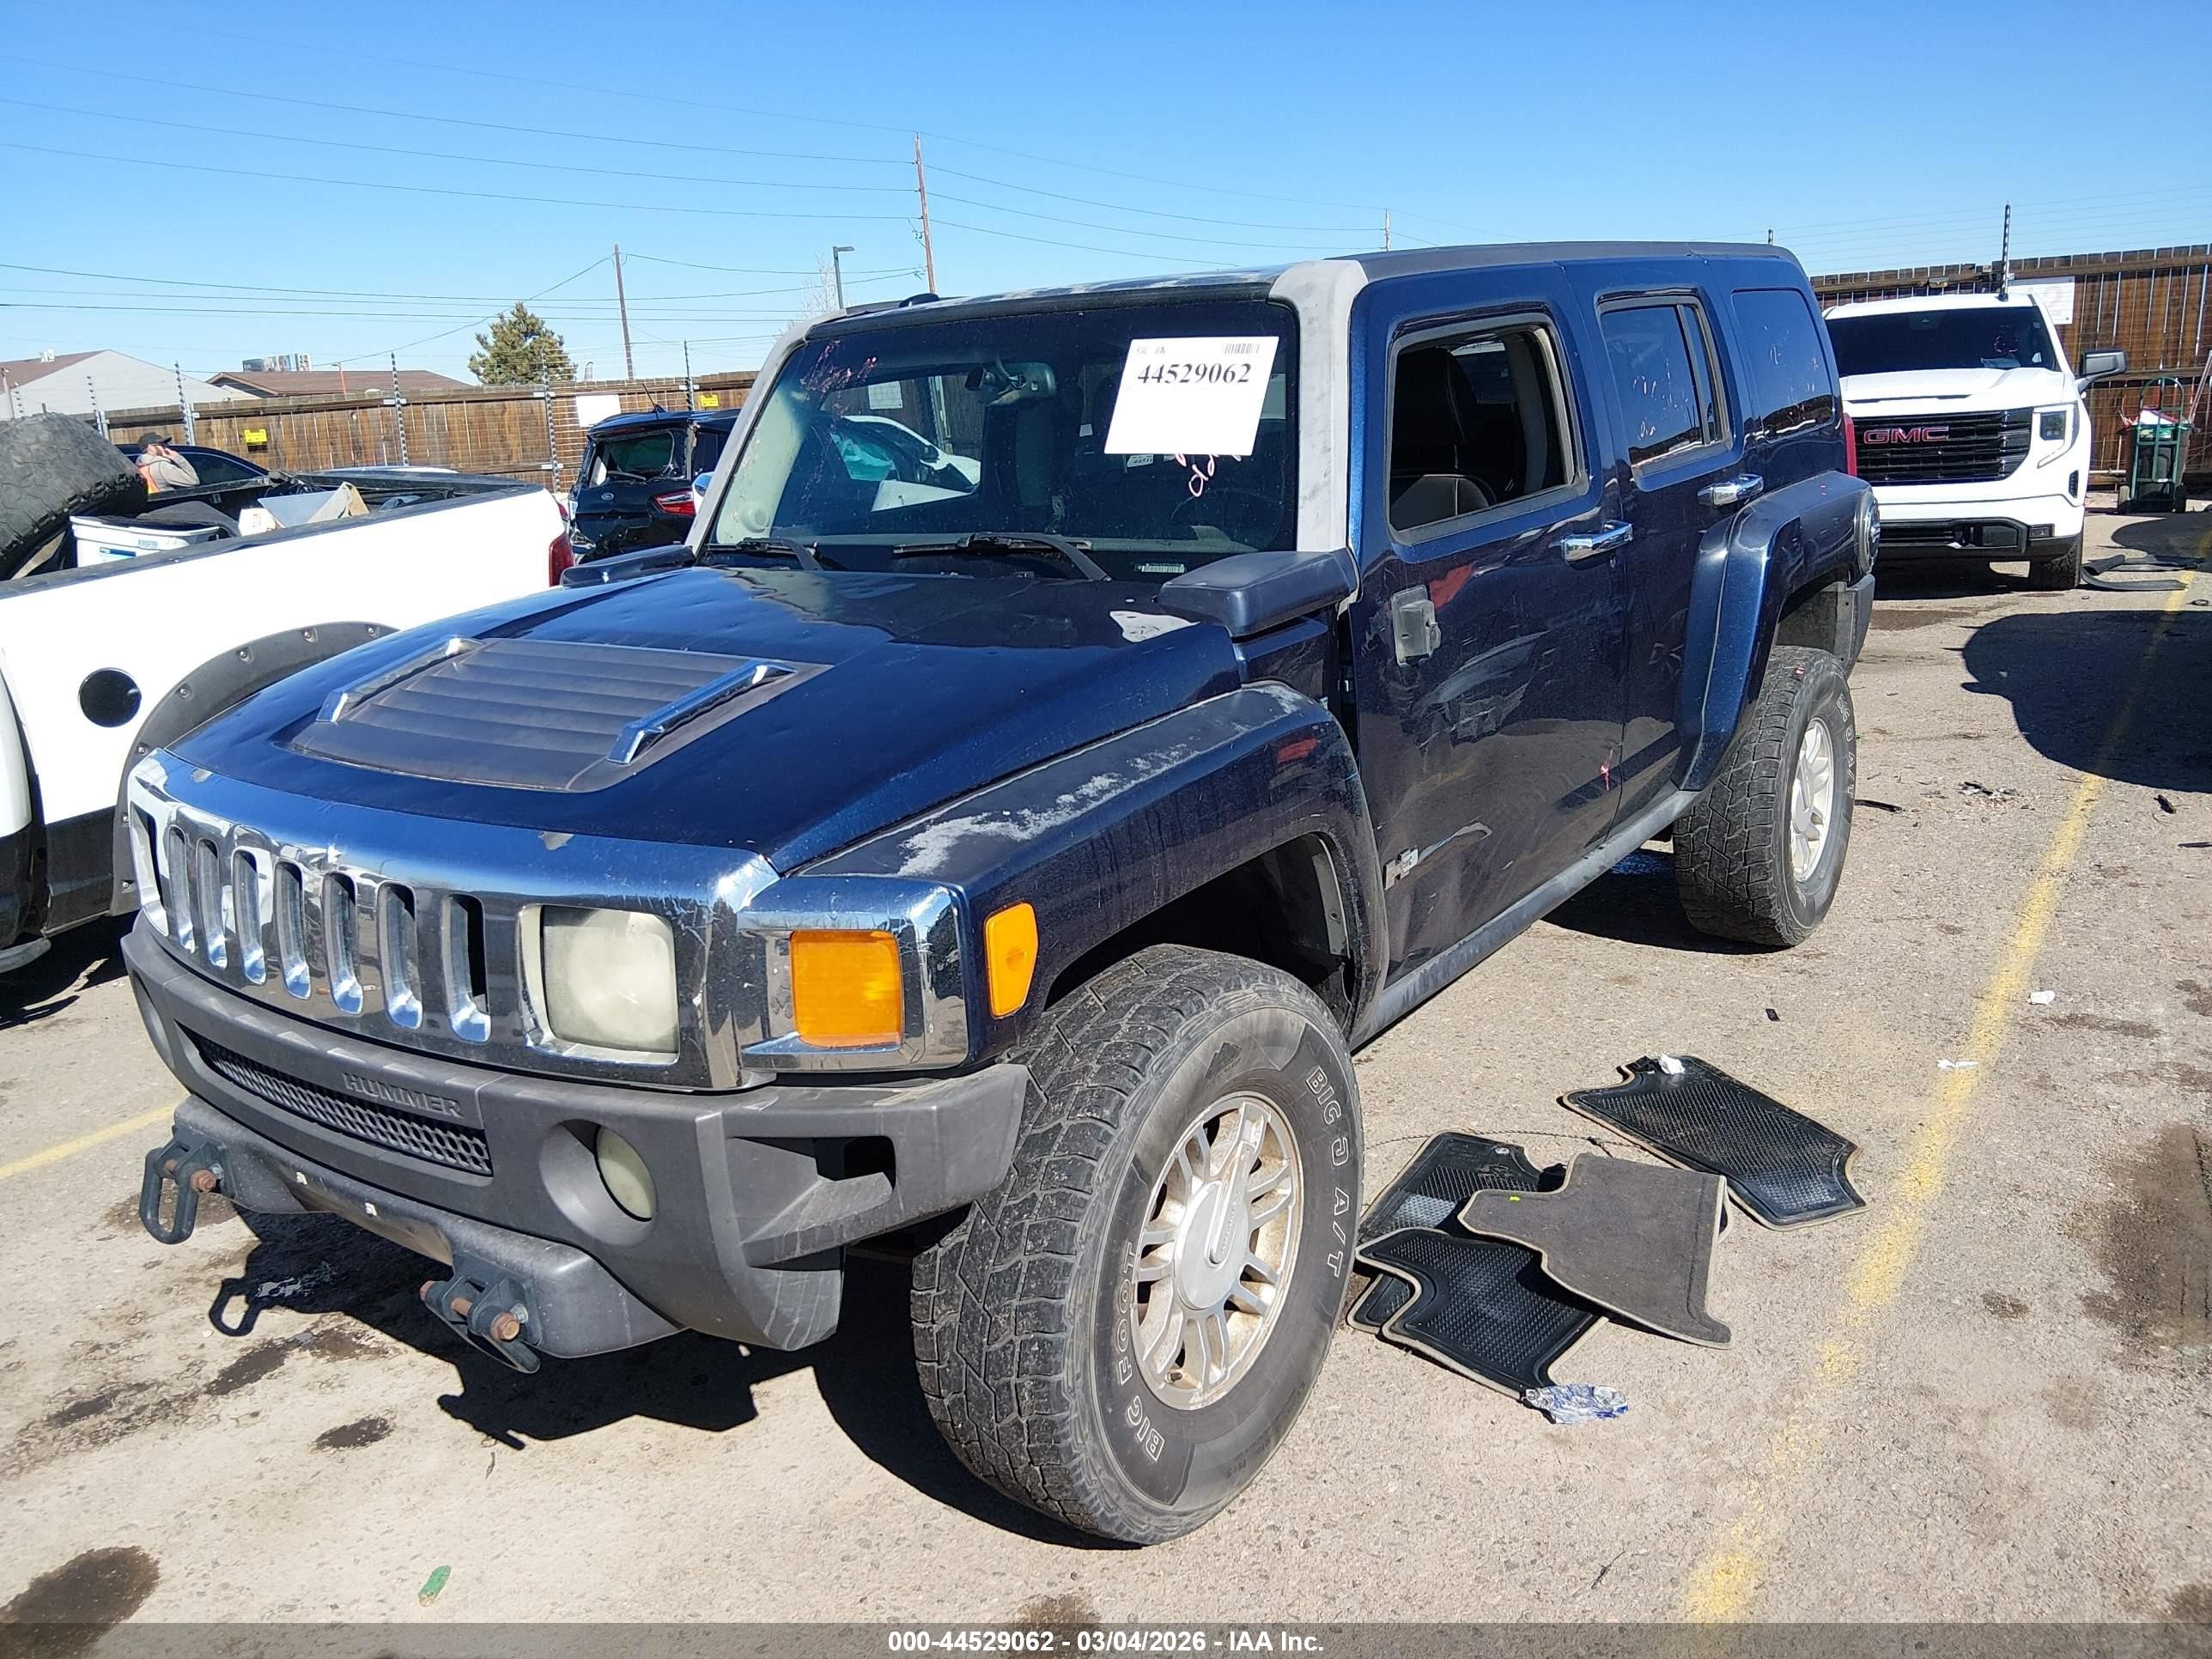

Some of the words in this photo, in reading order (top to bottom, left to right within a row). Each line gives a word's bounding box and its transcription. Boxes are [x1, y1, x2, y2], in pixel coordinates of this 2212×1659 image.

[1137, 363, 1252, 384] 44529062
[1863, 426, 1949, 444] GMC
[1383, 848, 1419, 890] H3
[343, 1072, 465, 1120] HUMMER
[1306, 1065, 1342, 1126] BIG
[1327, 1187, 1350, 1278] A/T
[1116, 1242, 1139, 1386] FOOT
[1127, 1395, 1165, 1462] BIG
